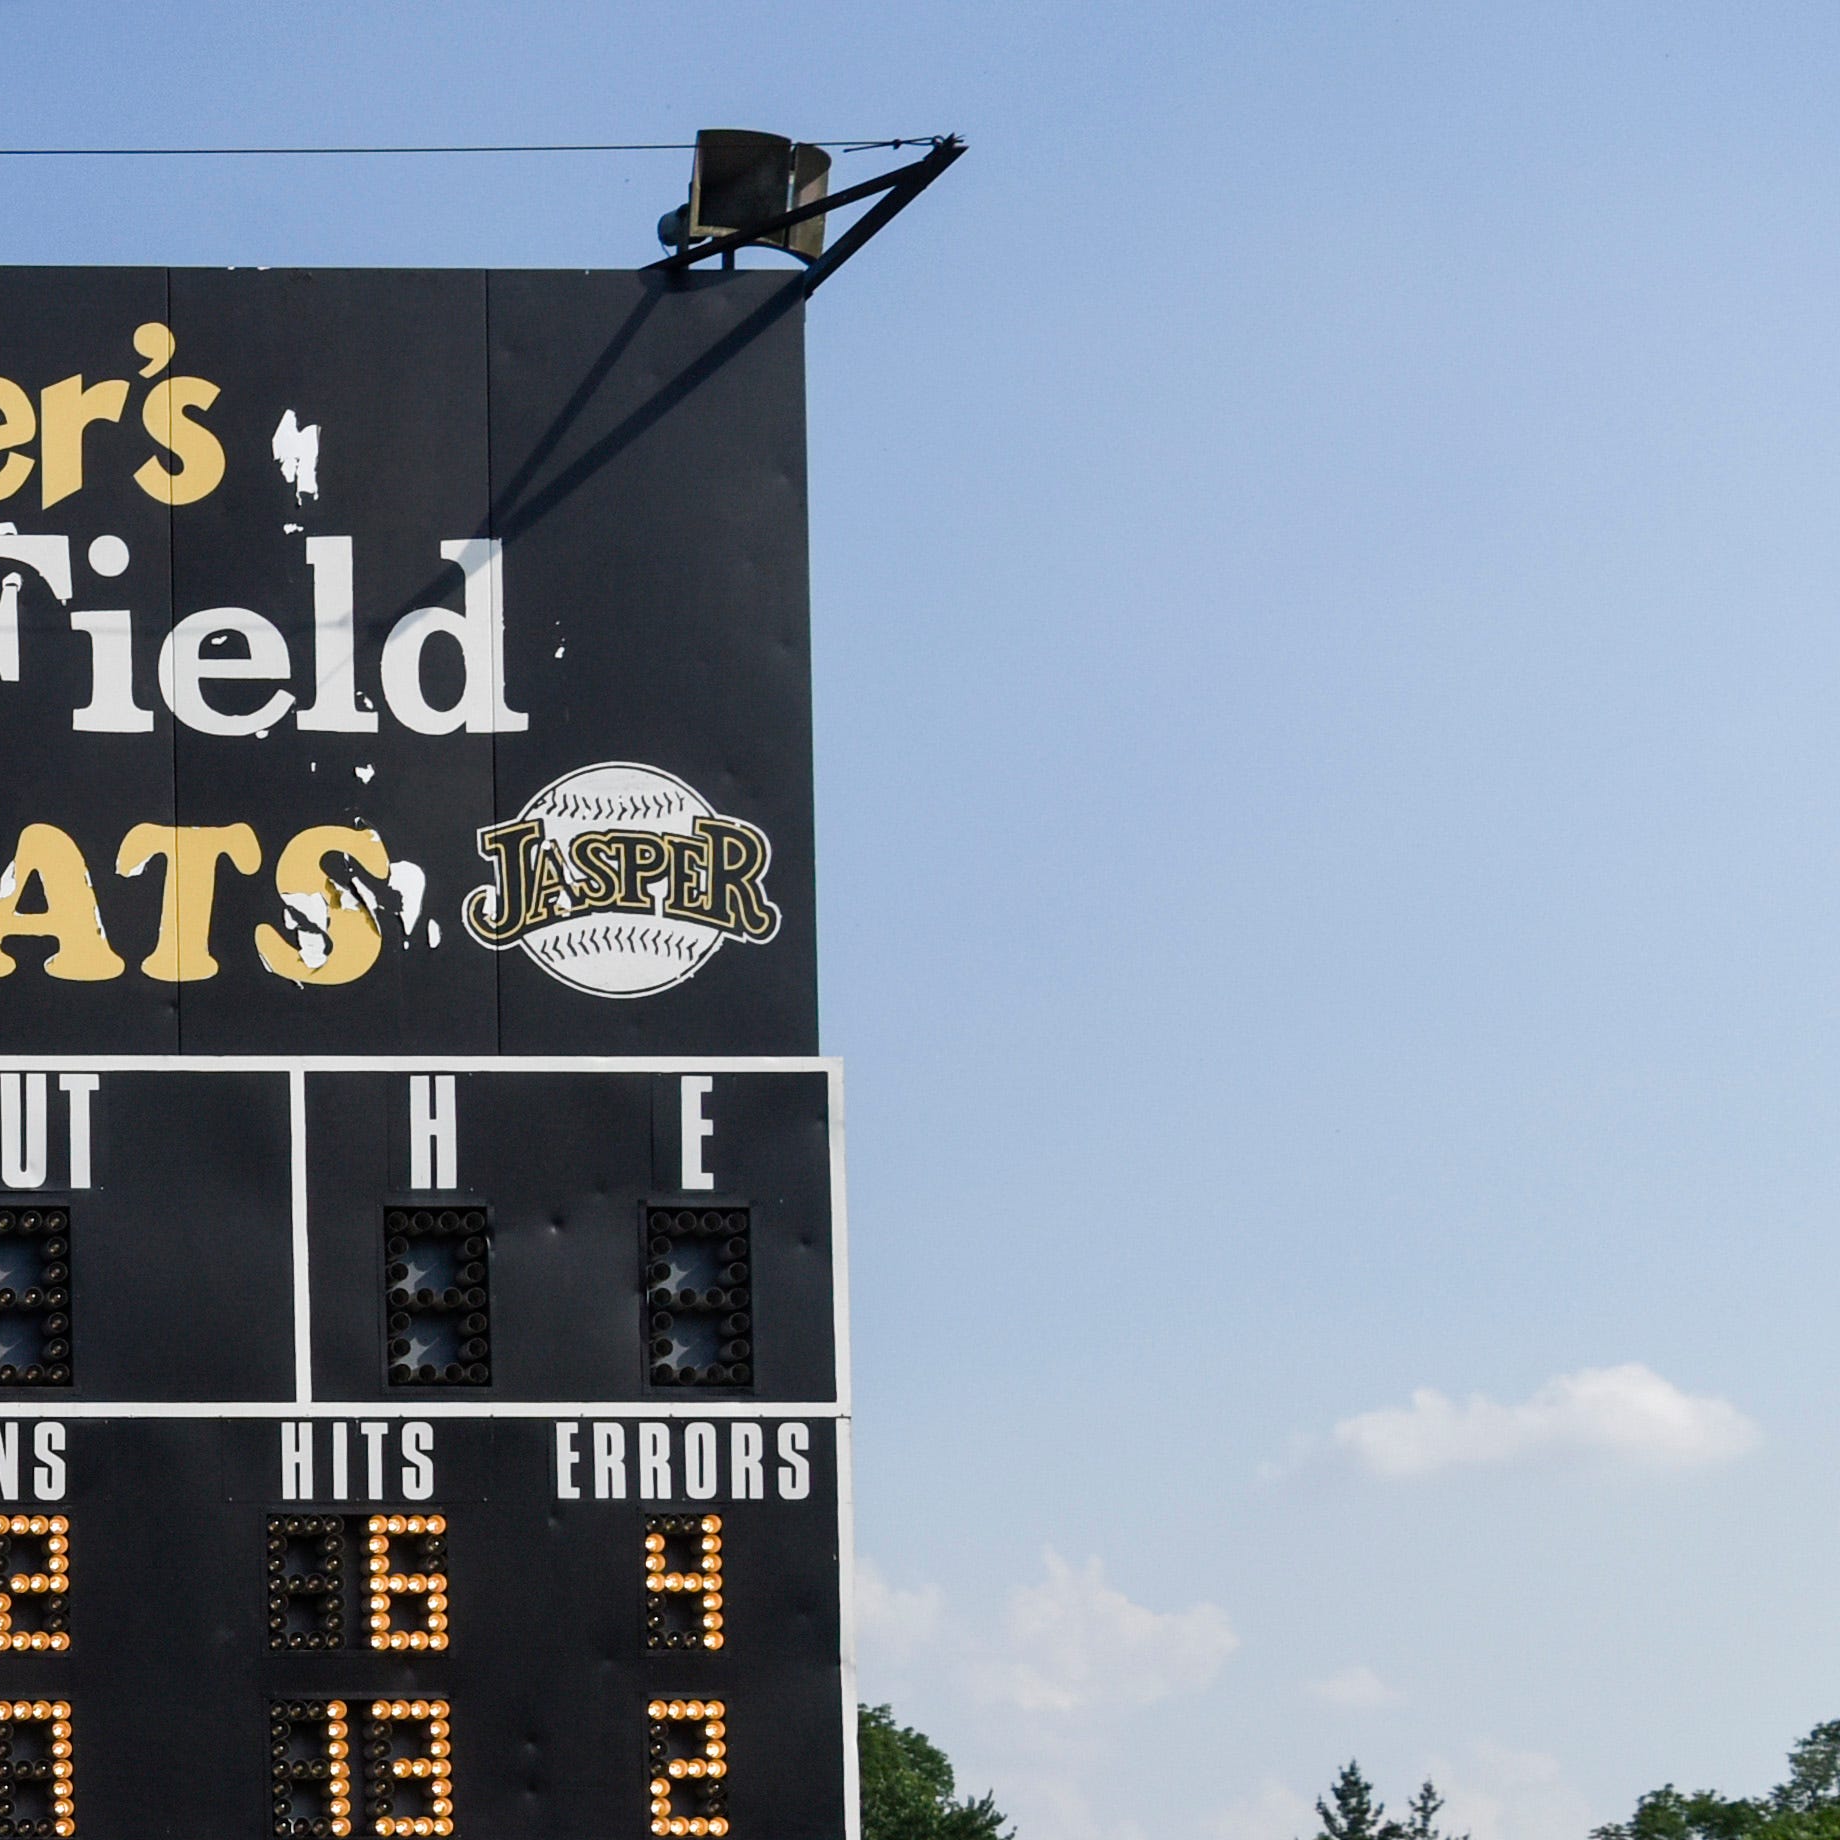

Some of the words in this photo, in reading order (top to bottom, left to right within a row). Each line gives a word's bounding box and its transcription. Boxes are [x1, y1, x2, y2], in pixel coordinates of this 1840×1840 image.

[475, 814, 775, 947] JASPER
[410, 1074, 458, 1190] H
[681, 1075, 714, 1190] E
[280, 1421, 435, 1500] HITS
[555, 1421, 811, 1500] ERRORS
[369, 1514, 448, 1650] 6
[644, 1514, 723, 1650] 4
[326, 1699, 454, 1837] 13
[647, 1699, 729, 1837] 2
